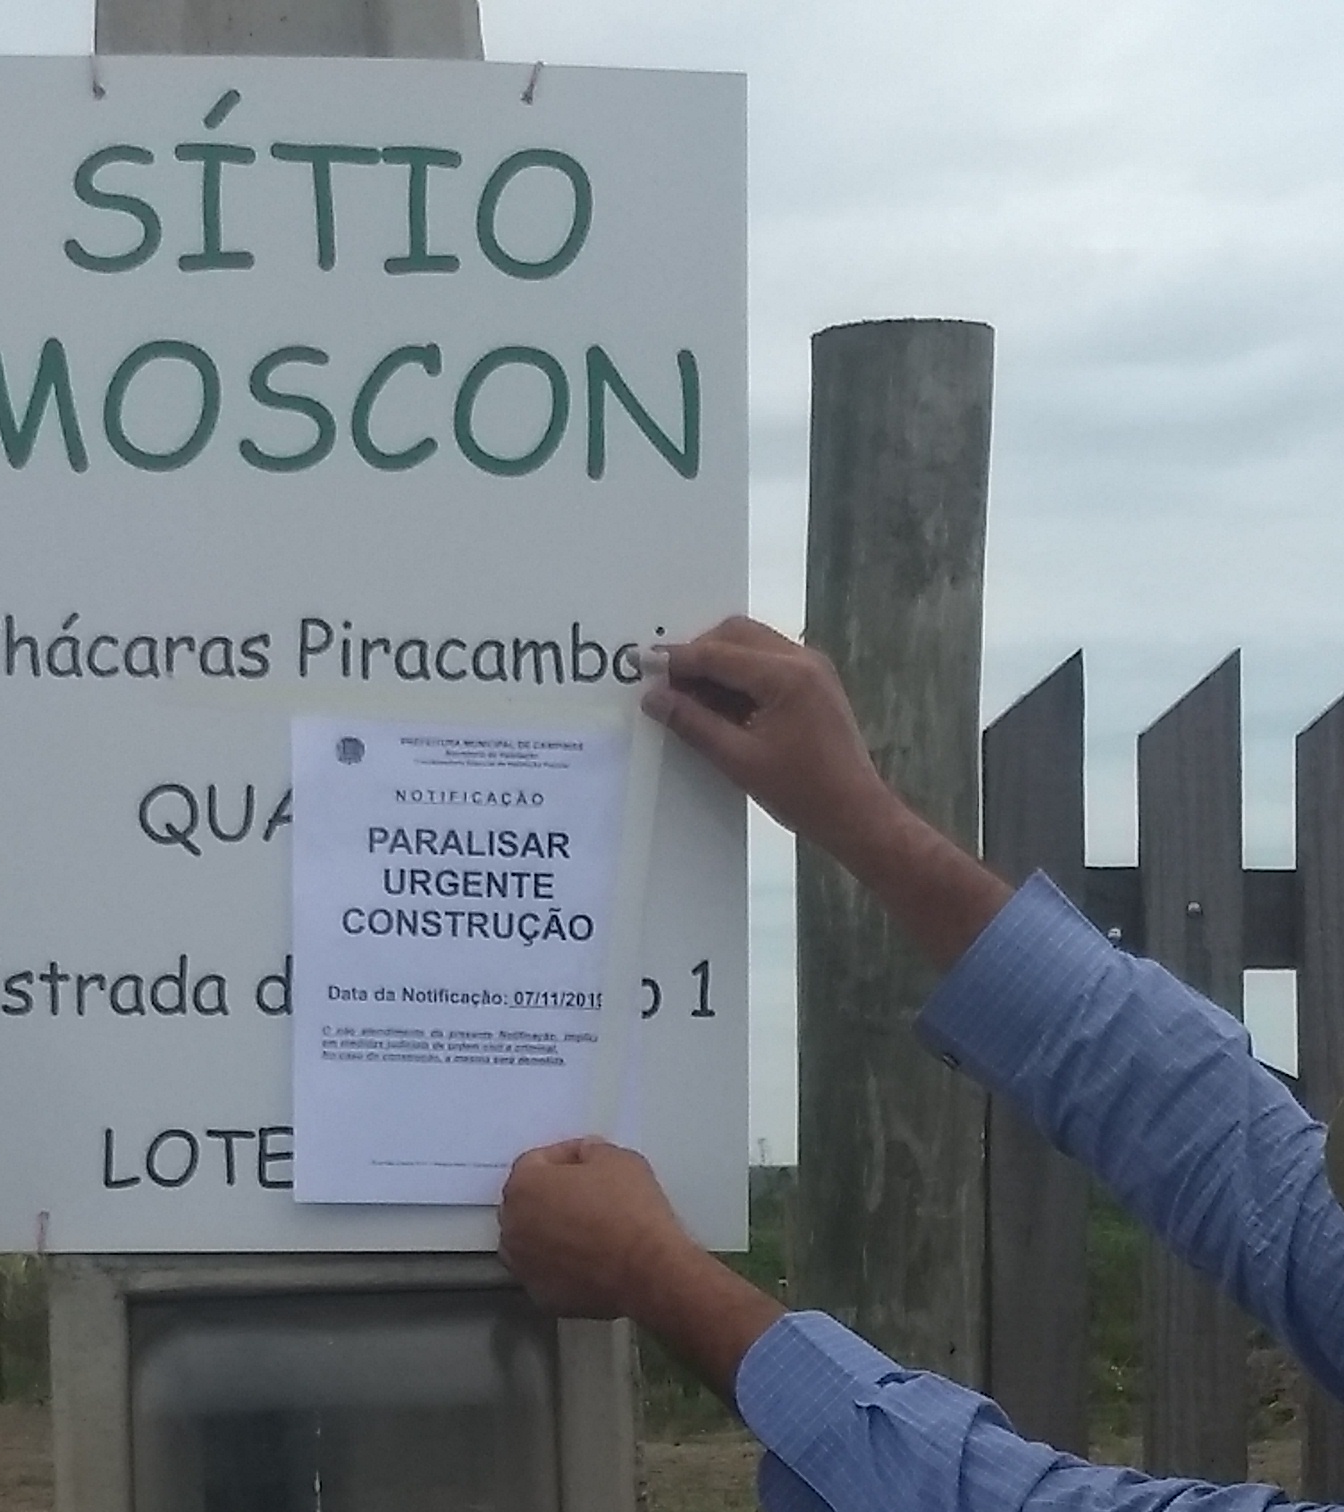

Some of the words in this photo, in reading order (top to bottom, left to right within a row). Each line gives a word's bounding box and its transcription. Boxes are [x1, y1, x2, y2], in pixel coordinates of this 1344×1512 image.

[63, 89, 593, 280] SÍTIO
[298, 618, 665, 686] Piracamba
[395, 788, 545, 807] NOTIFICAÇÃO
[368, 827, 572, 860] PARALISAR
[383, 868, 555, 900] URGENTE
[342, 907, 596, 947] CONSTRUÇÃO
[328, 985, 368, 1001] Data
[374, 987, 396, 1002] da
[402, 987, 509, 1007] Notificação:
[690, 959, 716, 1018] 1
[104, 1127, 294, 1188] LOTE
